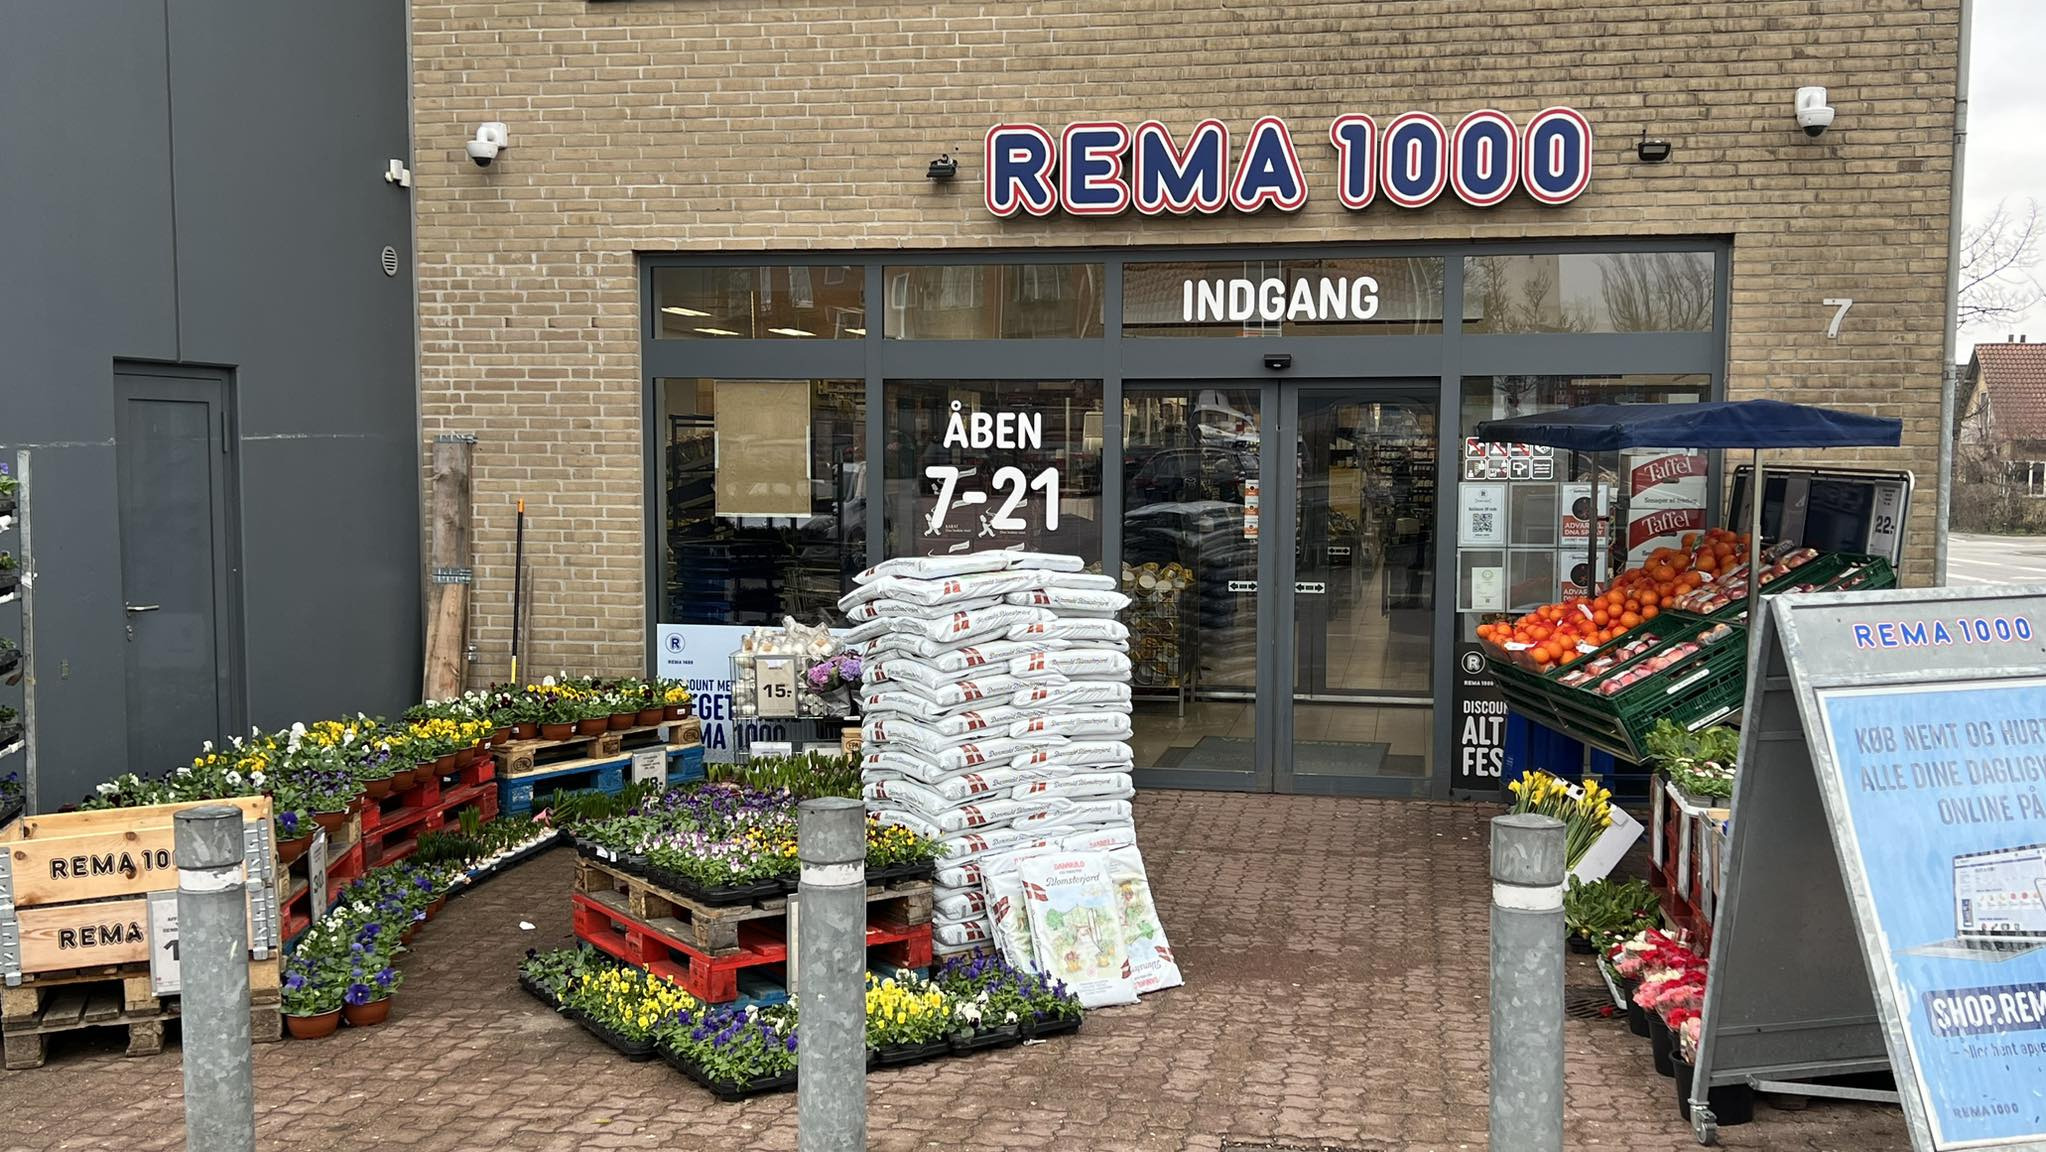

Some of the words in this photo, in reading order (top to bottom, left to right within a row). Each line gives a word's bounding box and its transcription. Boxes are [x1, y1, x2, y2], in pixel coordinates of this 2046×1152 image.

[984, 114, 1309, 217] REMA
[1329, 105, 1594, 209] 1000
[1183, 275, 1380, 322] INDGANG
[1823, 298, 1853, 339] 7
[943, 400, 1041, 449] ÅBEN
[1643, 456, 1692, 482] Taffel
[925, 466, 1059, 531] 7-21
[1641, 510, 1690, 536] Taffel
[1852, 619, 1953, 648] REMA
[1957, 615, 2033, 643] 1000
[1462, 715, 1504, 746] ALT
[1854, 725, 1897, 754] KØB
[1902, 722, 1960, 752] NEMT
[1965, 720, 1996, 748] OG
[1860, 764, 1908, 792] ALLE
[1910, 760, 1963, 789] DINE
[1938, 794, 2014, 825] ONLINE
[2016, 785, 2046, 820] PÅ
[50, 851, 137, 880] REMA
[58, 922, 144, 950] REMA
[1991, 1102, 2019, 1114] 1000
